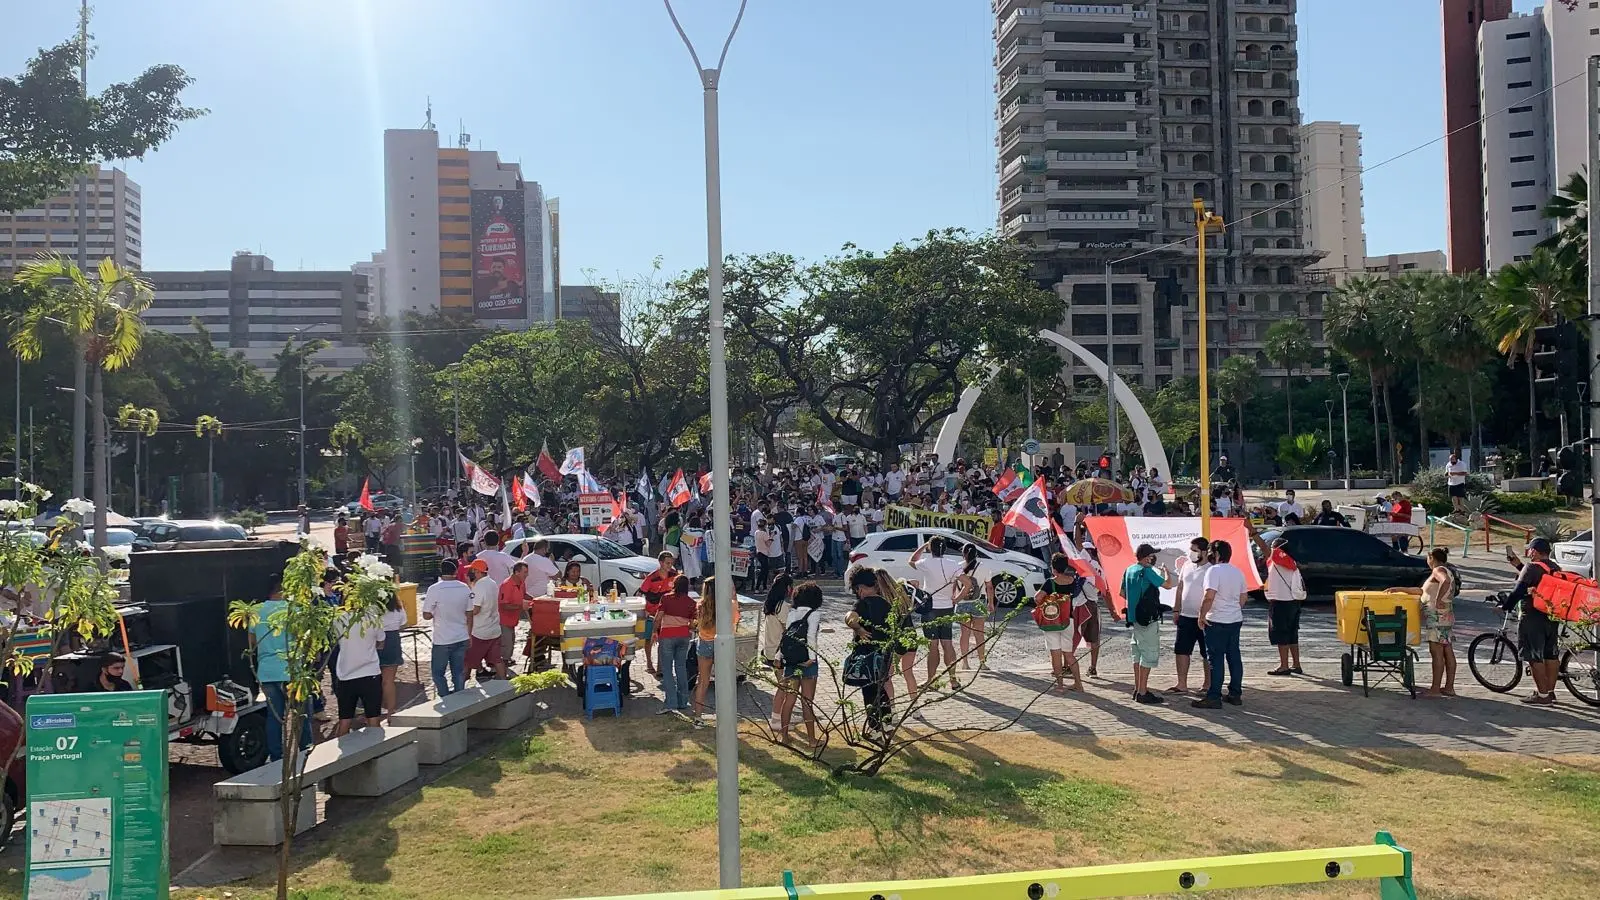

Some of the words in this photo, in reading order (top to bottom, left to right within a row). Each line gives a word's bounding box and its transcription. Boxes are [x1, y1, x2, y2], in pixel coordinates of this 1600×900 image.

[56, 736, 78, 750] 07
[30, 754, 50, 762] Praça
[51, 752, 82, 760] Portugal
